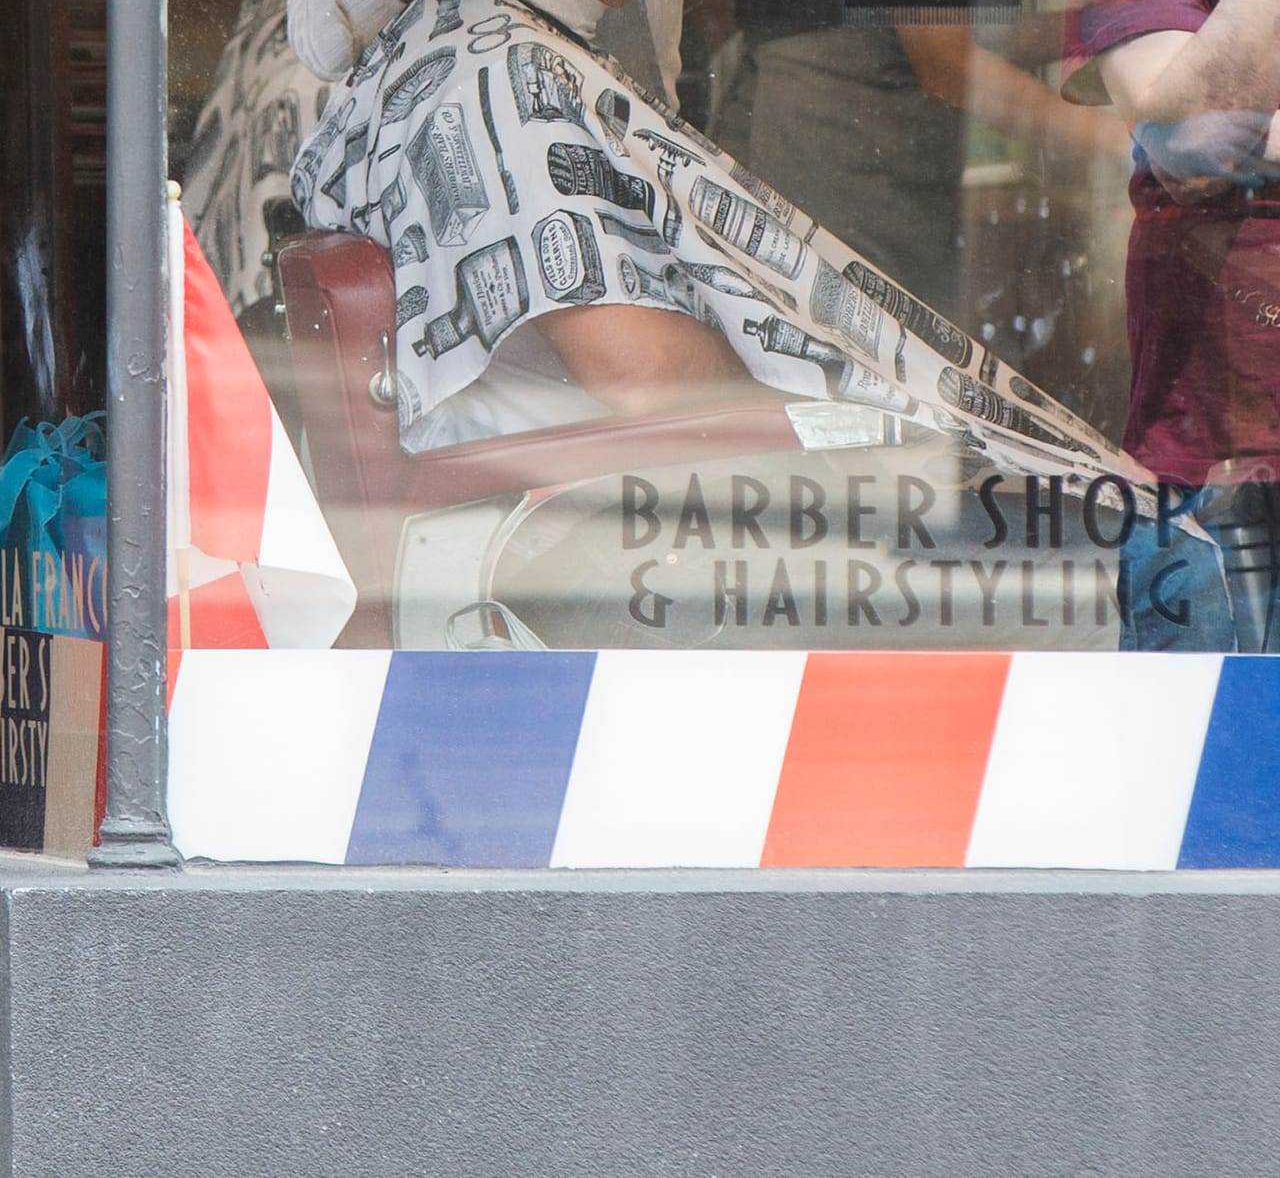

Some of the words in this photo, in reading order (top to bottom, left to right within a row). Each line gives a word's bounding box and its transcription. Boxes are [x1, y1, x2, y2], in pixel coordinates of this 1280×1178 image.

[546, 264, 558, 283] FELS
[549, 223, 568, 286] GLYCERINE
[621, 473, 937, 551] BARBER
[978, 473, 1192, 550] SHOP
[627, 558, 674, 628] &
[714, 558, 1192, 628] HAIRSTYLING
